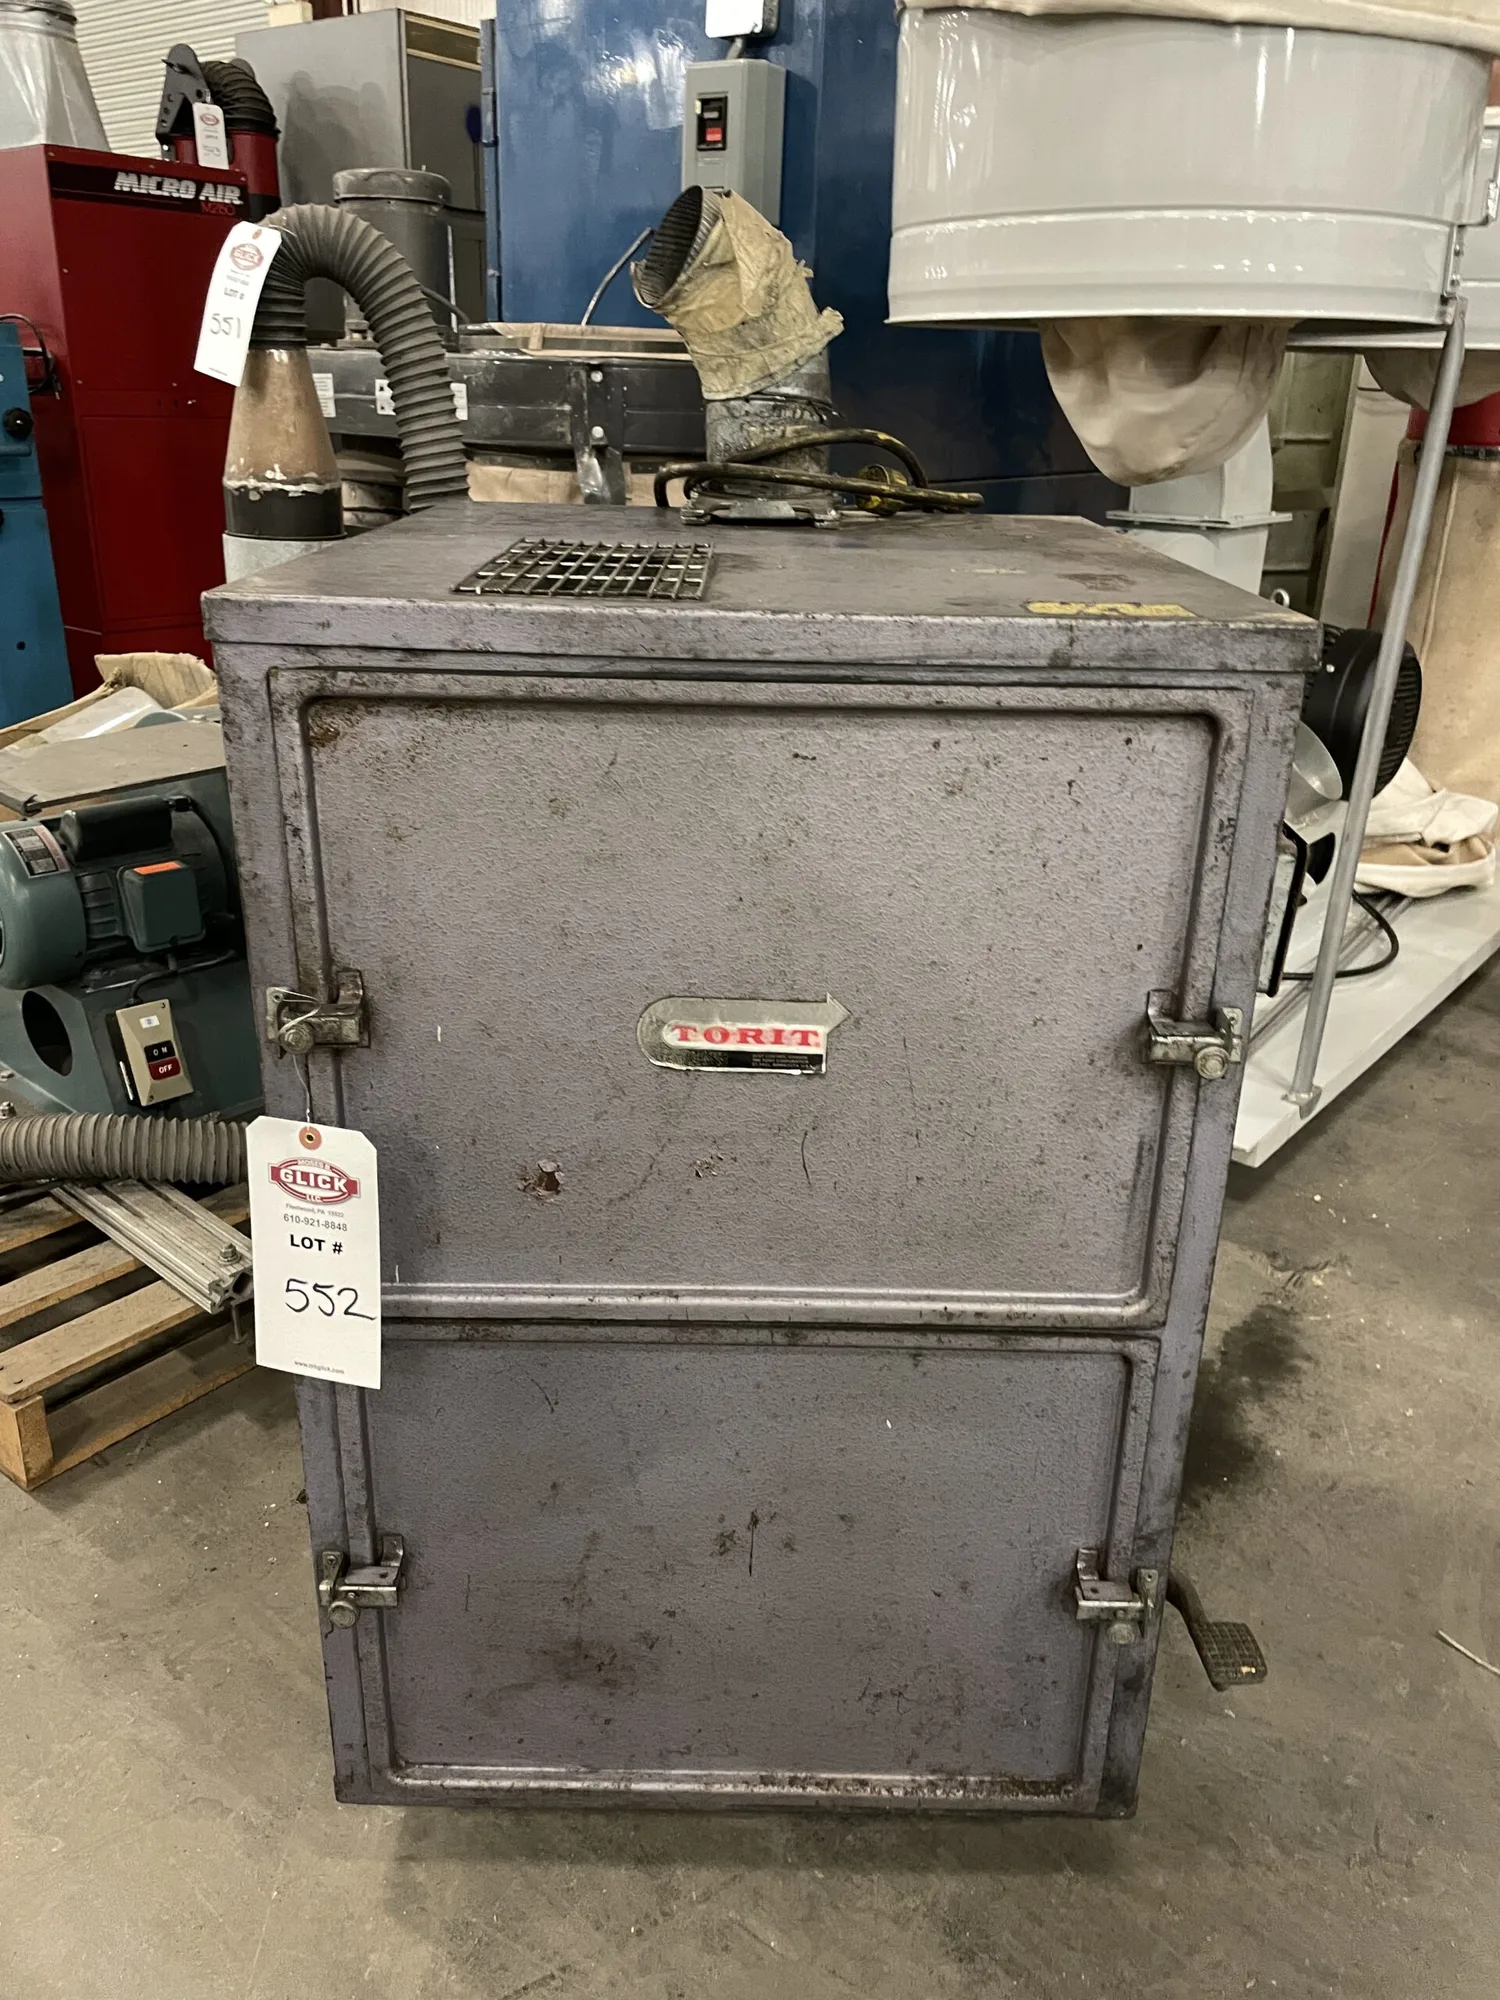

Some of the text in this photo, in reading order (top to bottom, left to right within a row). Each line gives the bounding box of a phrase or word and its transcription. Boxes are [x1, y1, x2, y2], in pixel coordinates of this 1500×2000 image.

[113, 171, 243, 205] MICRO AIR
[210, 313, 242, 339] 551
[671, 1025, 819, 1047] TORIT
[153, 1046, 167, 1056] ON
[158, 1064, 172, 1074] OFF
[279, 1168, 348, 1193] GLICK
[283, 1213, 348, 1232] 610-921-8848
[290, 1233, 343, 1255] LOT #
[285, 1278, 377, 1321] 552
